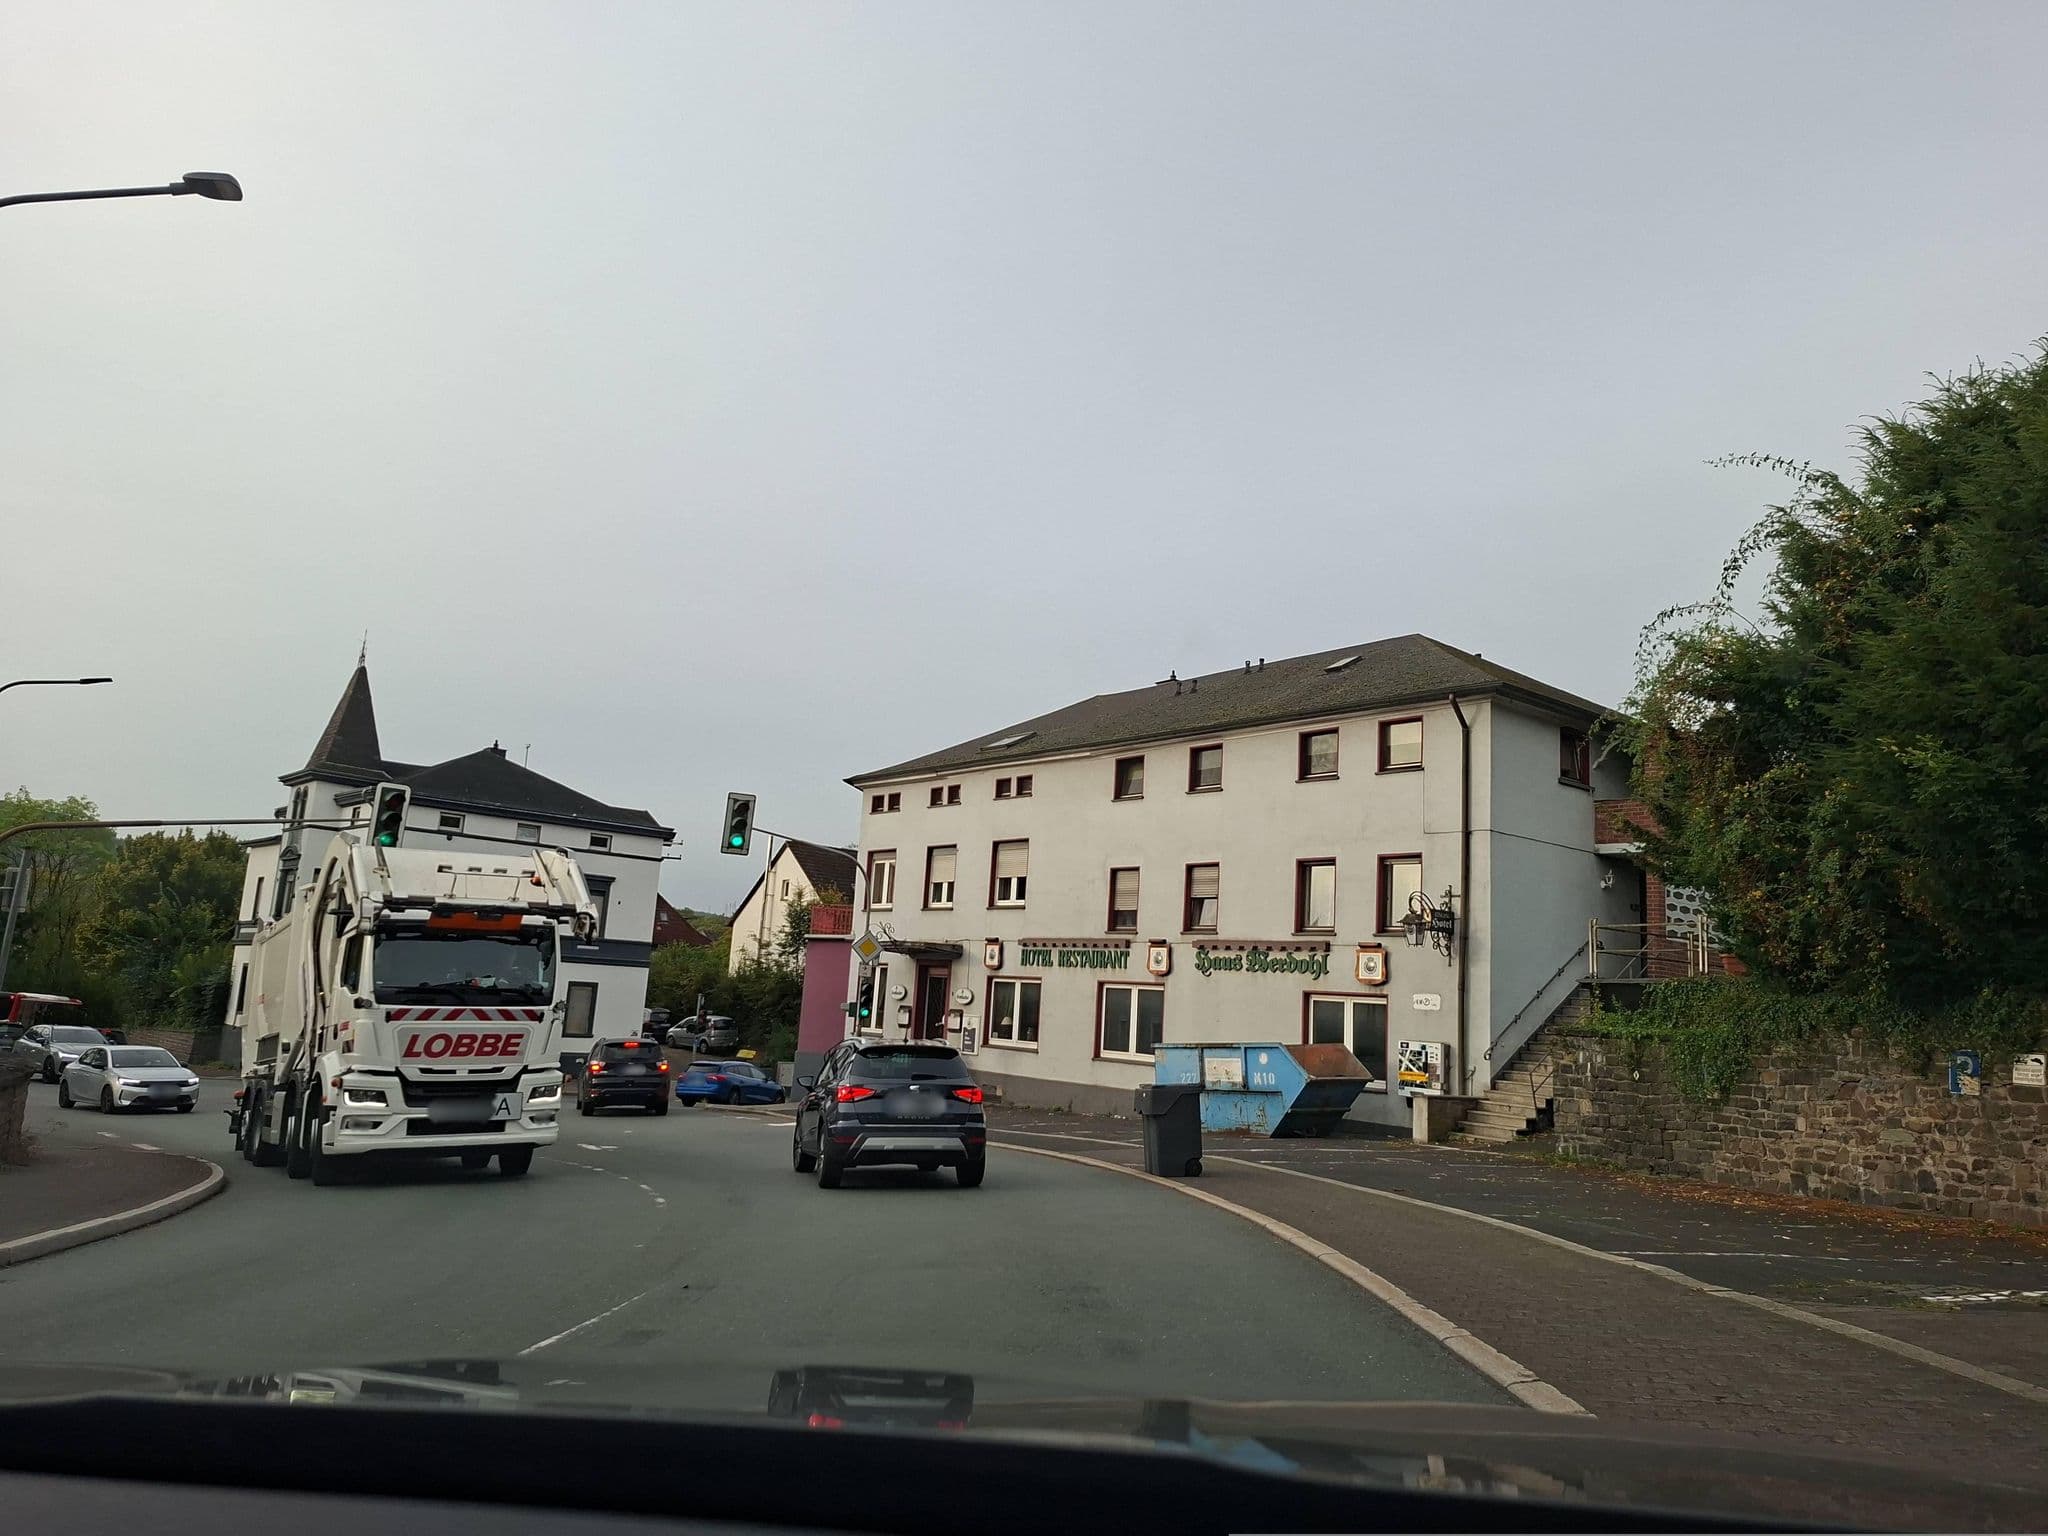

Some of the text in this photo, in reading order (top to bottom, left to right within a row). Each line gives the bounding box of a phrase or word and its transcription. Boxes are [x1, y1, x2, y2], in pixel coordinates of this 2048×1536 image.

[1020, 948, 1130, 969] HOTEL RESTAURANT
[1194, 949, 1331, 981] Haus Werdohl
[402, 1033, 525, 1058] LOBBE
[495, 1097, 512, 1116] A
